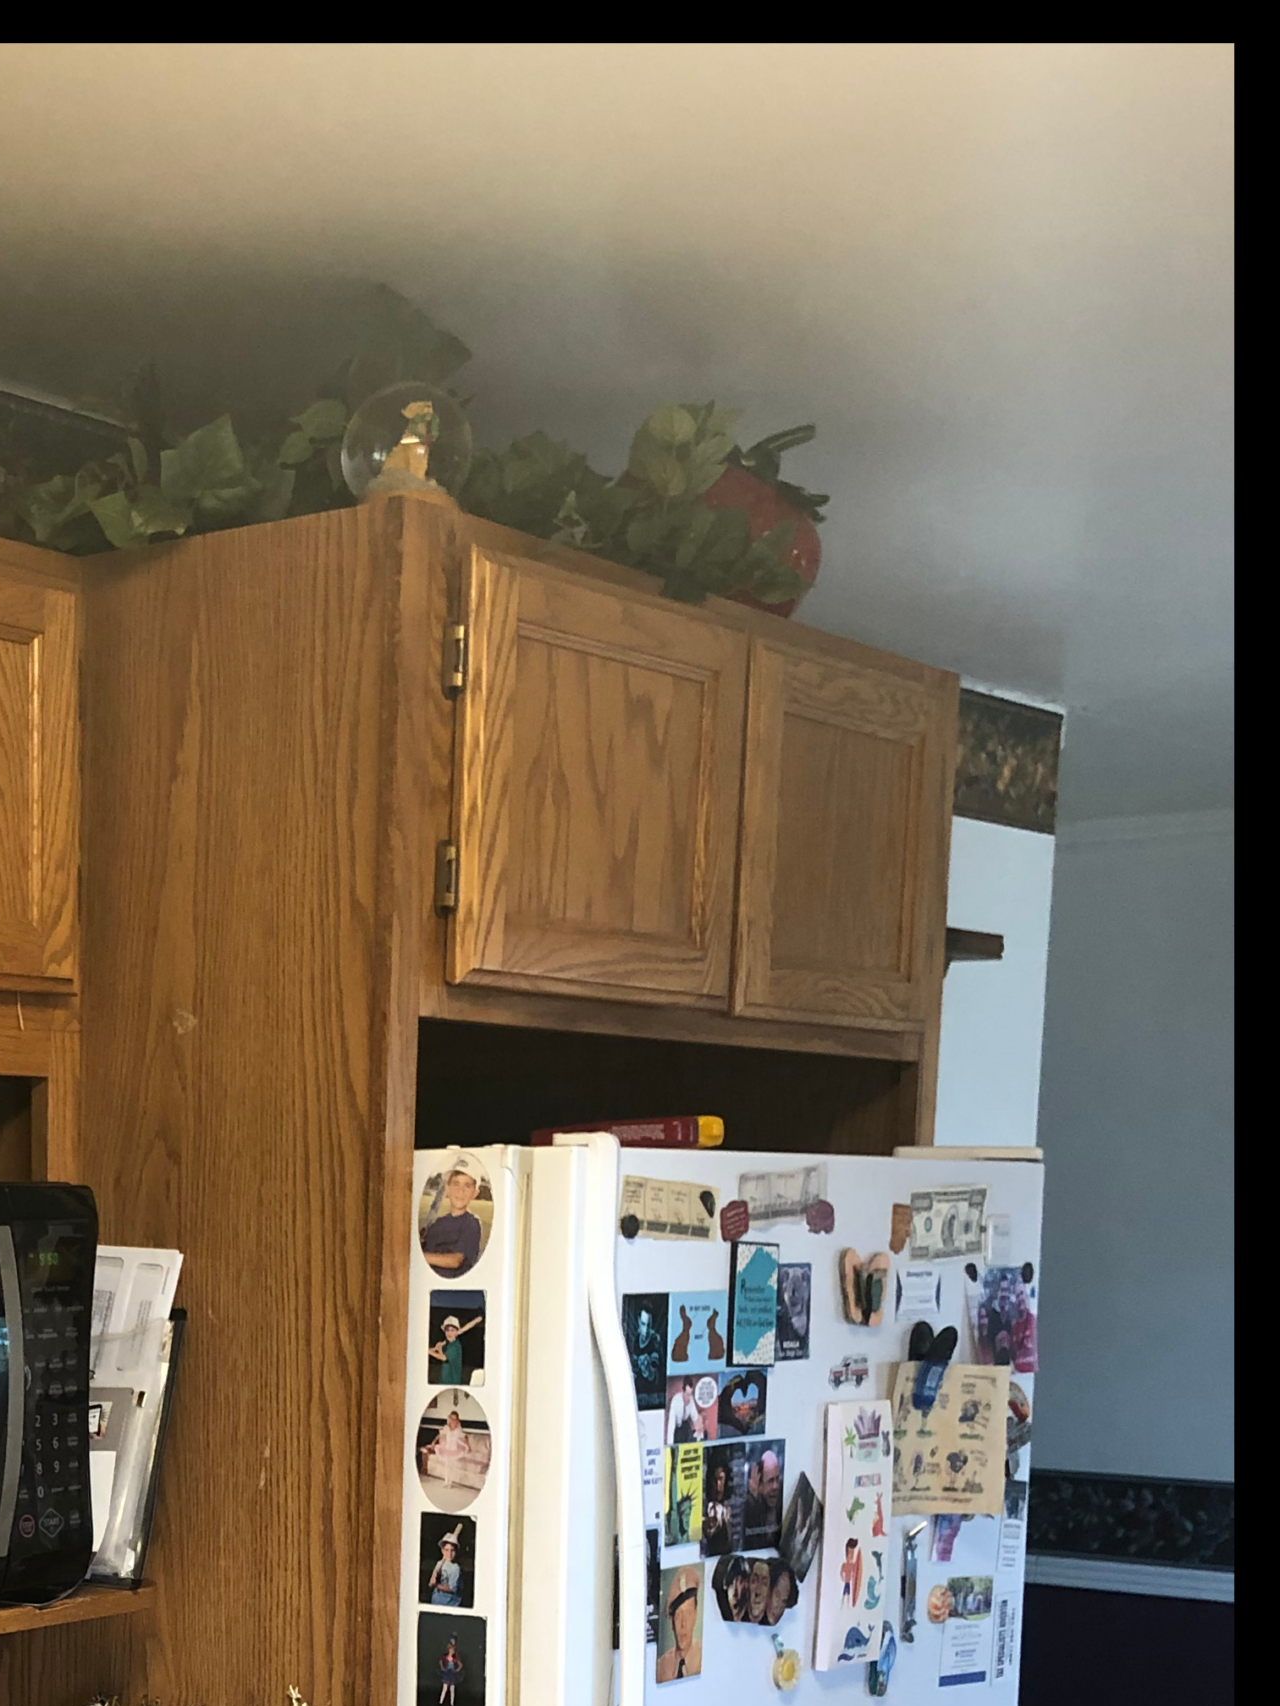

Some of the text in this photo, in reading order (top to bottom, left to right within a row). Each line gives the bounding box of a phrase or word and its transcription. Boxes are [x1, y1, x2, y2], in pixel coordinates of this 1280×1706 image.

[52, 1413, 58, 1426] 3
[36, 1437, 59, 1451] 5 6
[54, 1461, 60, 1473] 9
